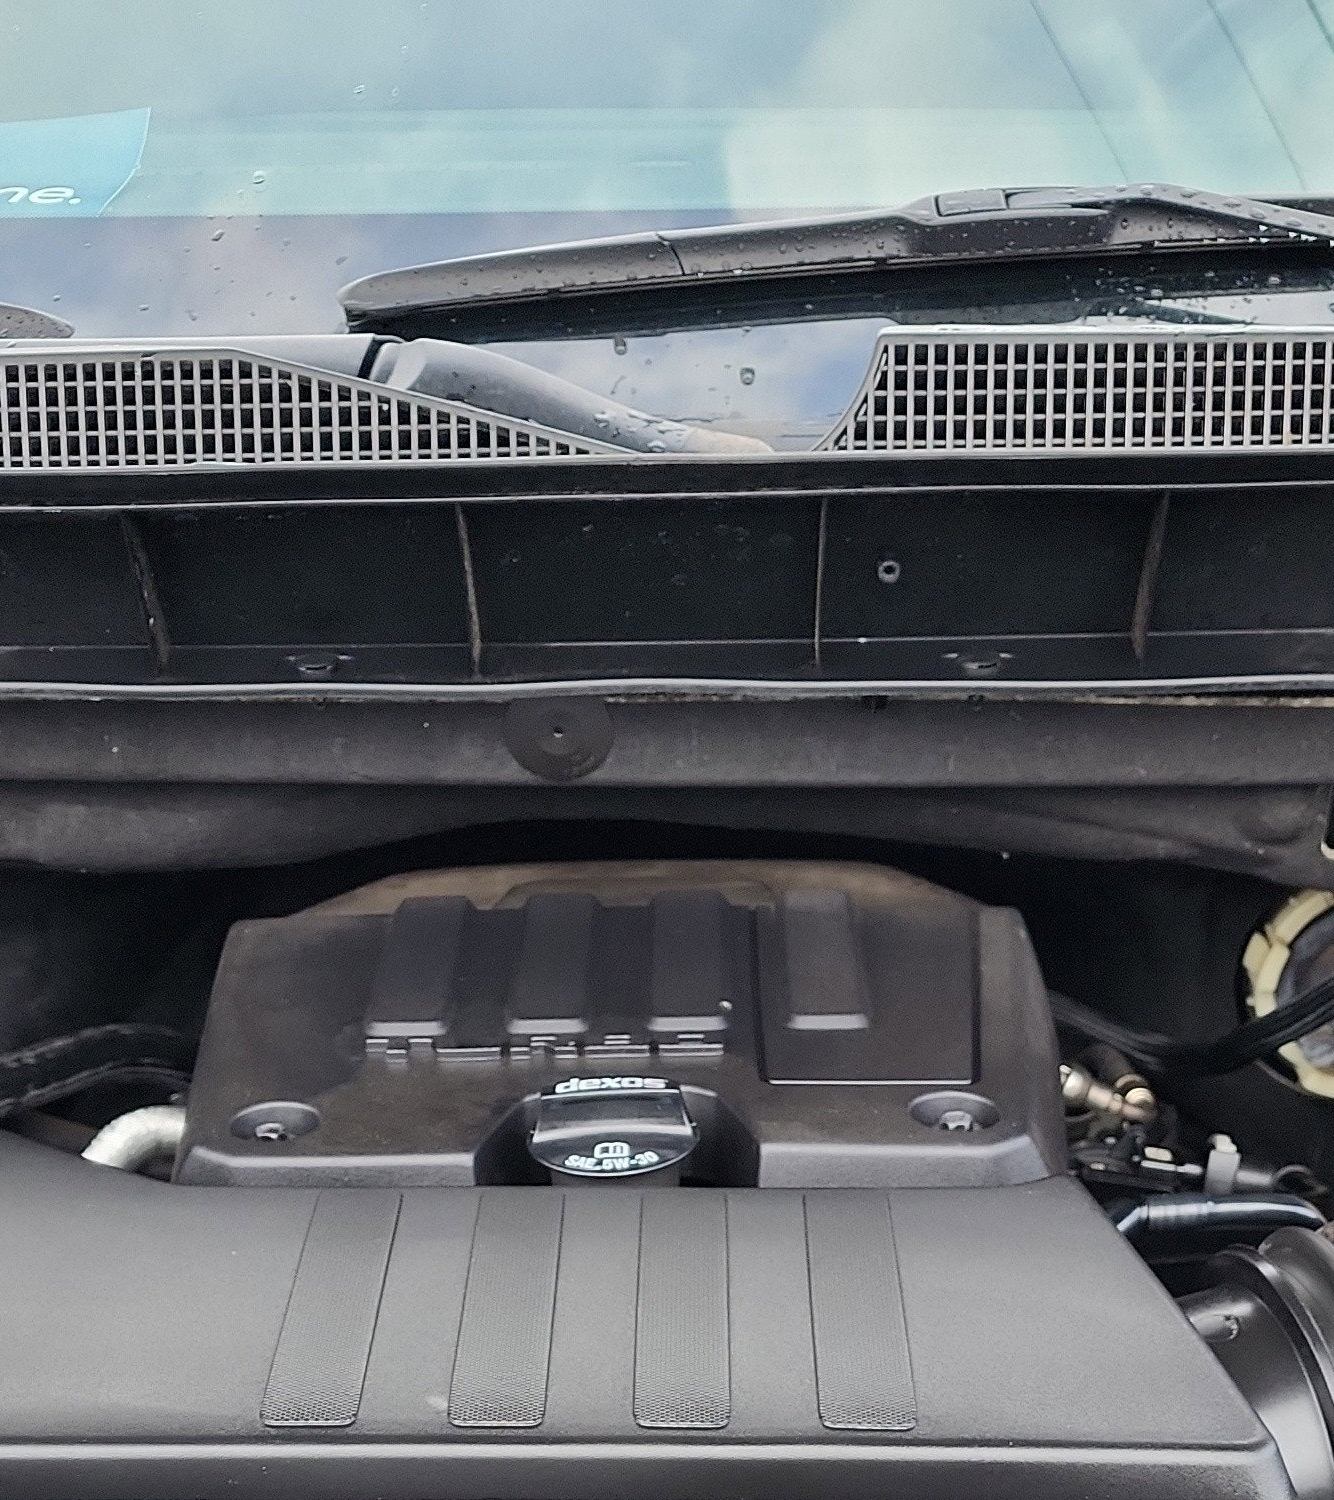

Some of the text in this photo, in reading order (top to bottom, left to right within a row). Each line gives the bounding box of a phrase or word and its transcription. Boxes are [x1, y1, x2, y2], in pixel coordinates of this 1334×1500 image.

[555, 1077, 669, 1093] dexos
[564, 1150, 660, 1171] SAE 5W-30
